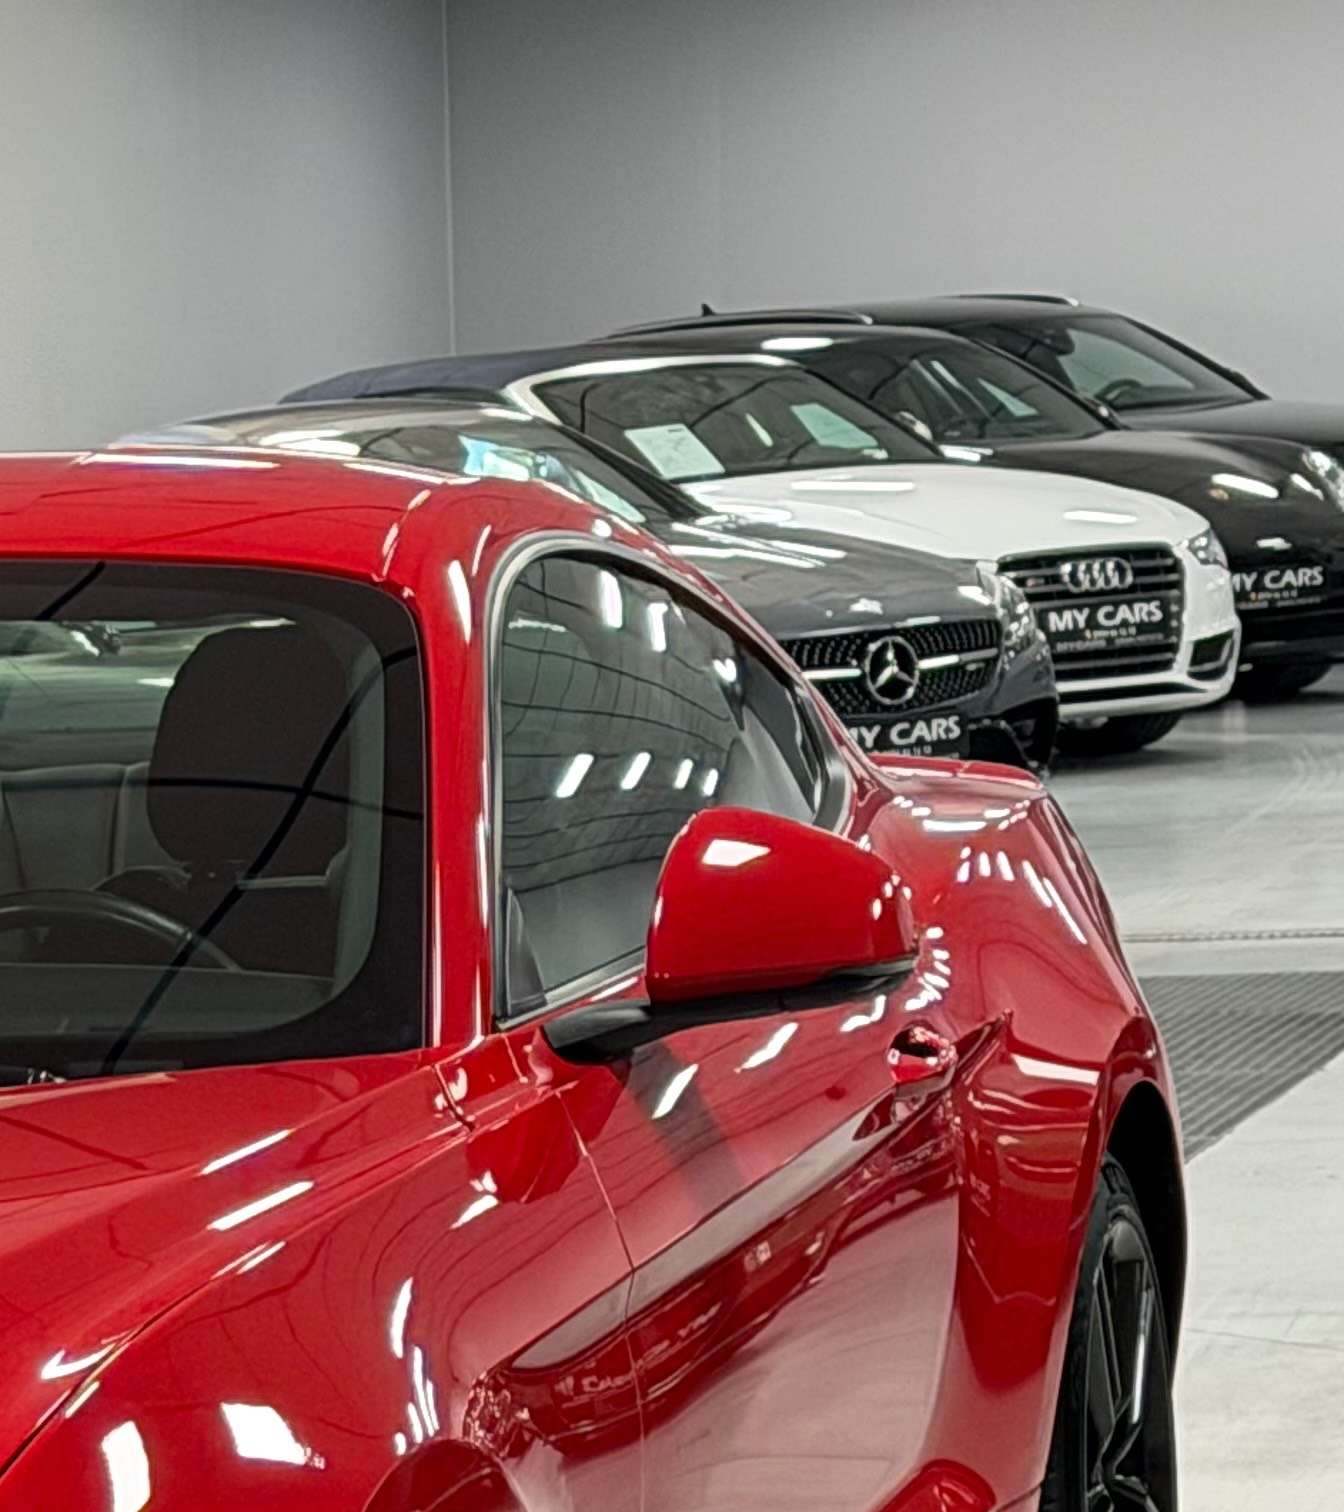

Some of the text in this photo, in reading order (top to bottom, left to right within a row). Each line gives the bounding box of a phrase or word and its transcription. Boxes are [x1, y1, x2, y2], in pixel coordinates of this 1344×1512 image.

[1263, 566, 1324, 589] CARS
[1047, 607, 1090, 632] MY
[1097, 600, 1163, 626] CARS
[890, 715, 961, 745] CARS
